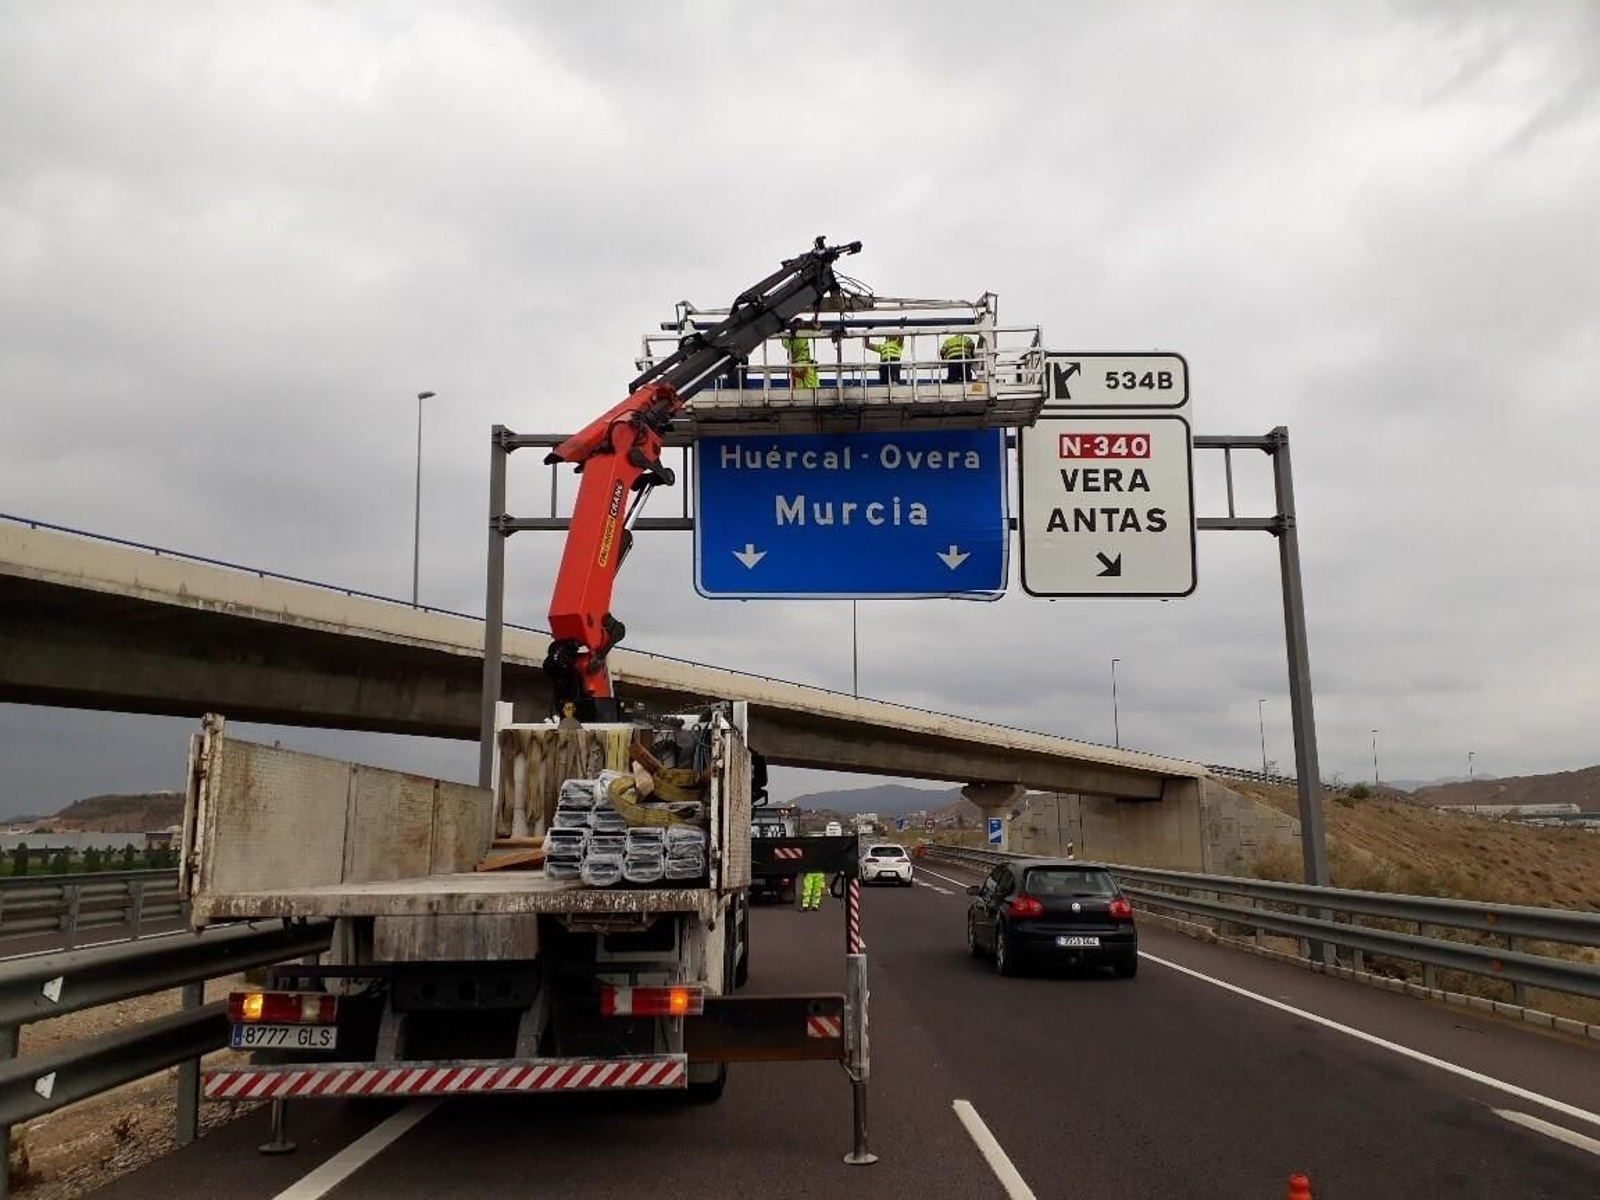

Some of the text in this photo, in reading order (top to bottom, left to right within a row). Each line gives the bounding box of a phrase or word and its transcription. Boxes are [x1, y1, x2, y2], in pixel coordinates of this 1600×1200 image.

[1105, 371, 1173, 390] 534B
[721, 445, 851, 470] Huércal
[879, 444, 981, 470] Overa
[1061, 436, 1148, 457] N-340
[1060, 468, 1151, 493] VERA
[775, 495, 929, 526] Murcia
[1046, 507, 1168, 533] ANTAS
[245, 1026, 331, 1047] 8777 GLS
